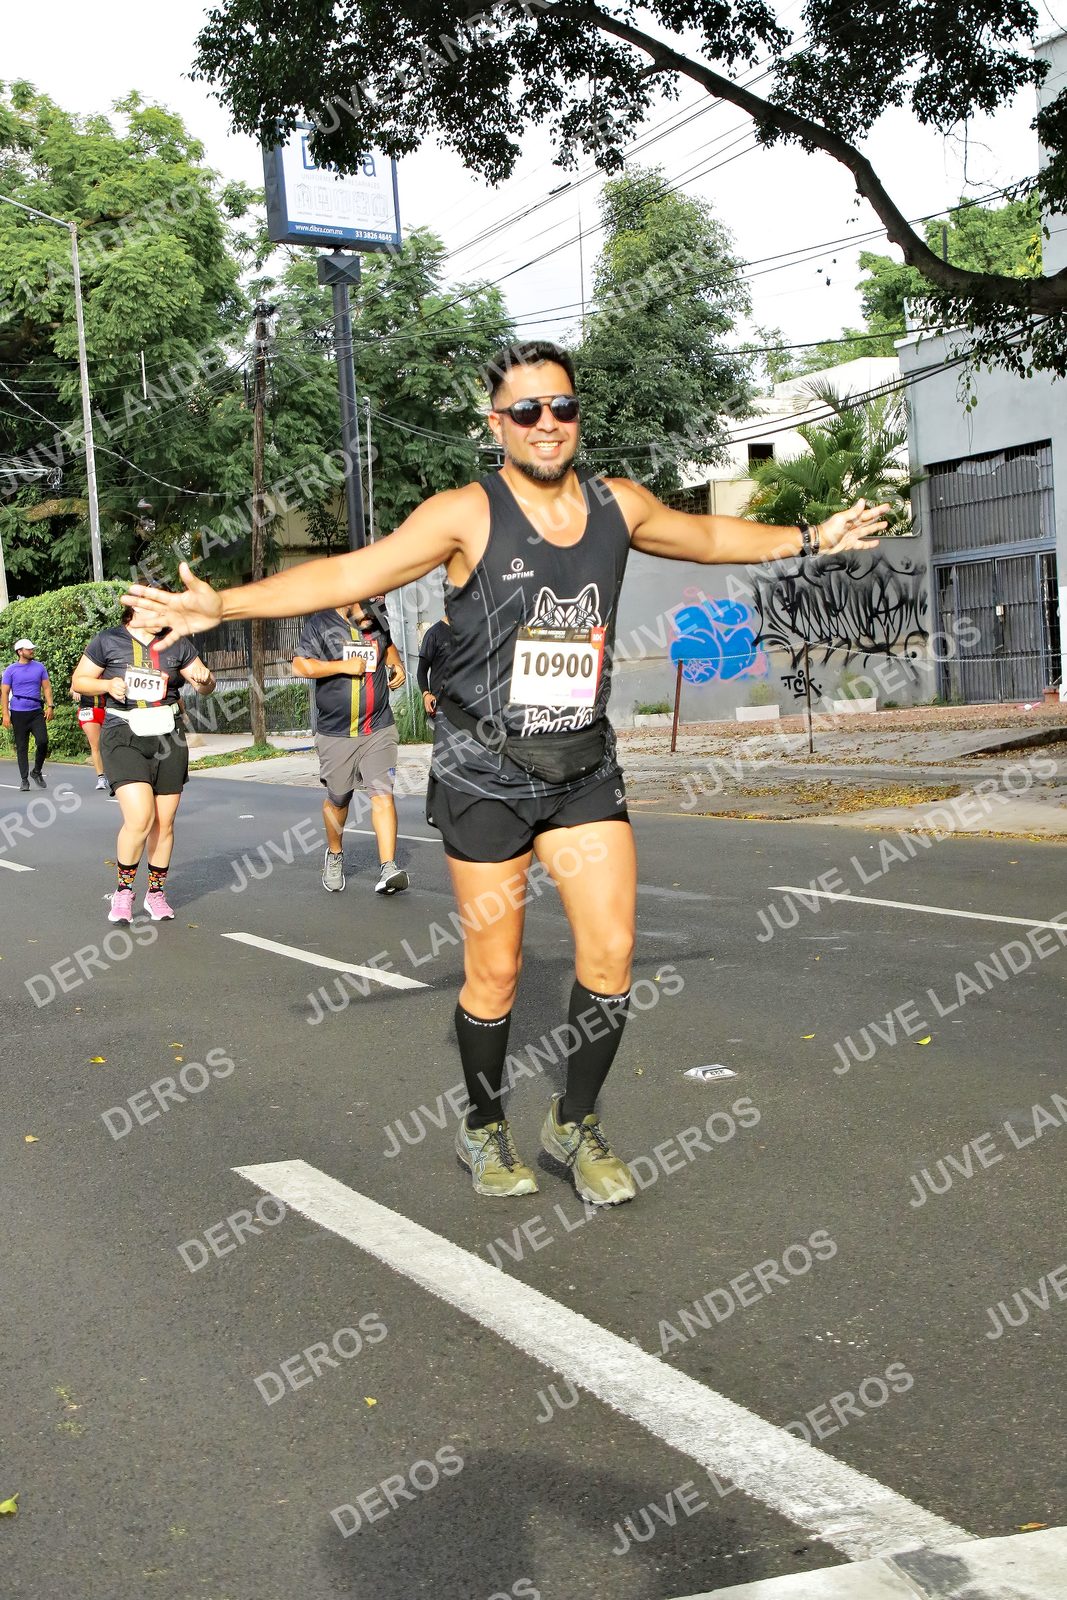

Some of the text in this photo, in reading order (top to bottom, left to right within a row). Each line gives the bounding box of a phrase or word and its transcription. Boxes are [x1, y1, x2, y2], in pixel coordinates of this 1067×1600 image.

[502, 570, 535, 581] TOPTIME
[346, 650, 375, 661] 10645
[521, 651, 594, 679] 10900
[127, 676, 161, 690] 10651
